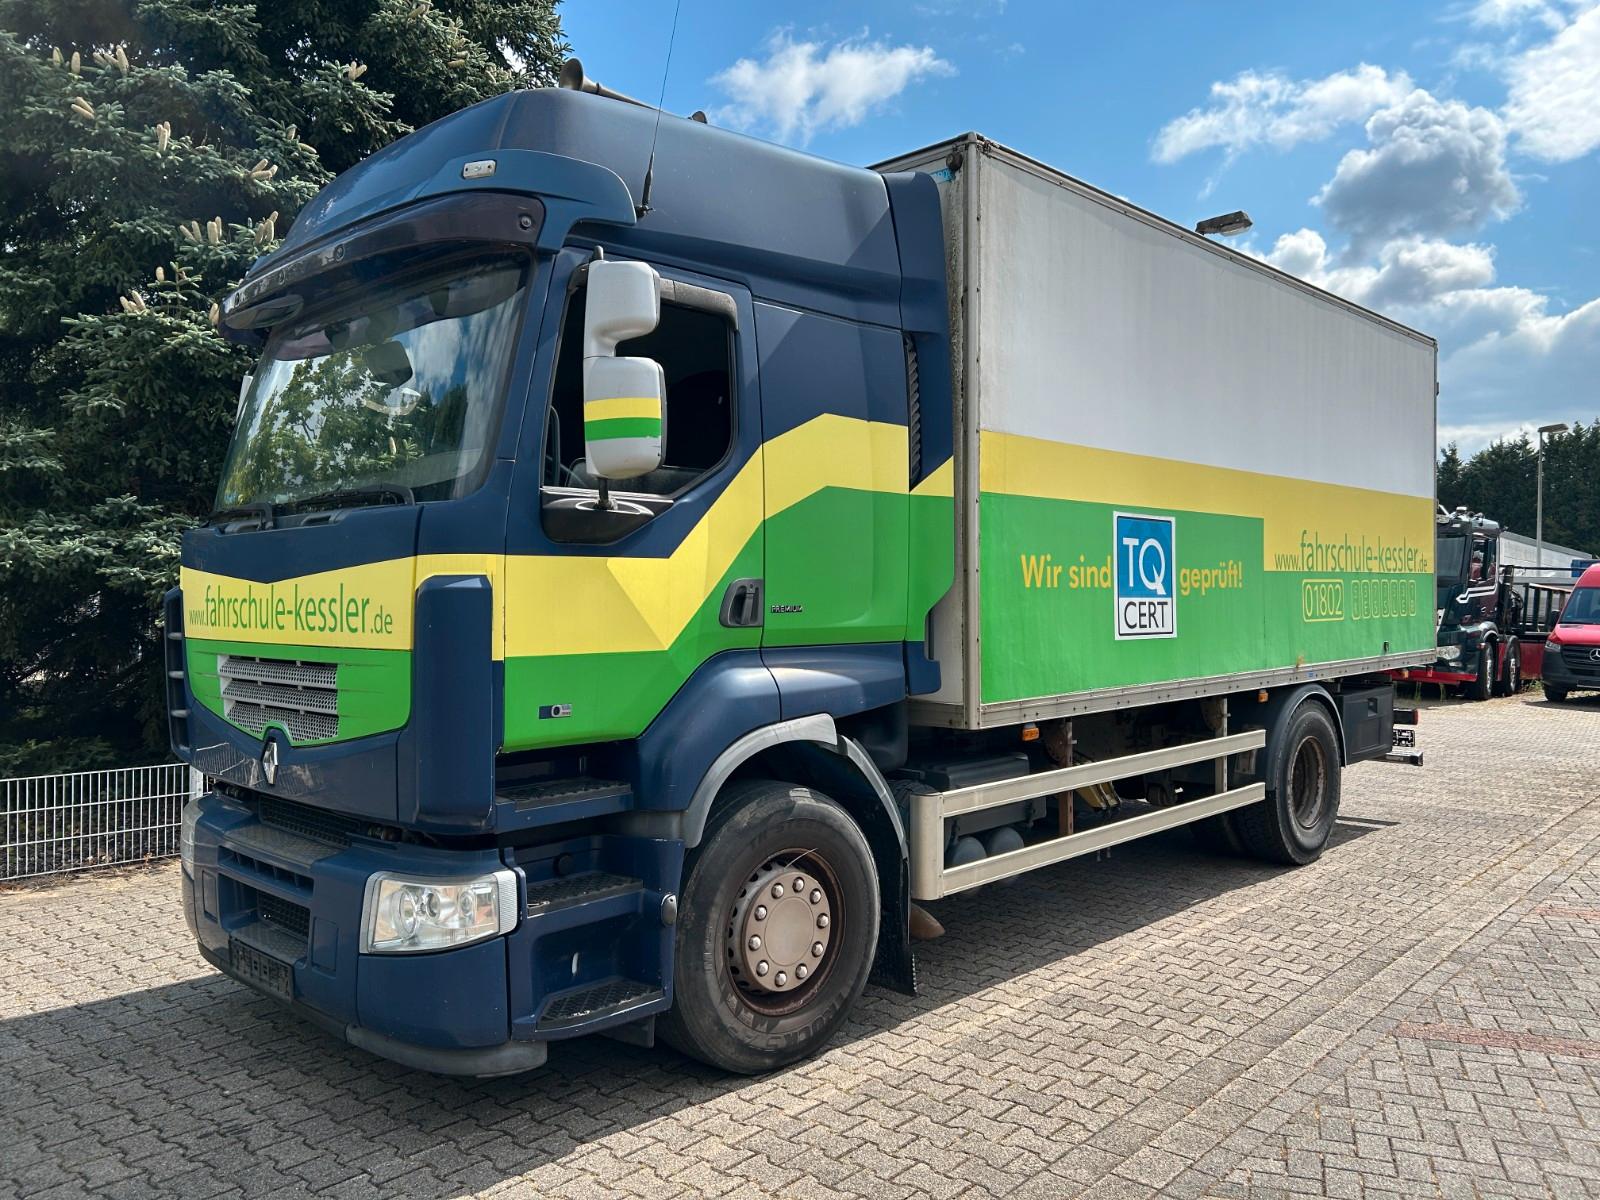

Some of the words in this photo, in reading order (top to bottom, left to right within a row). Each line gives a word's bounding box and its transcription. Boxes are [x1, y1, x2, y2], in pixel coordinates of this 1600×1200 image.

[1122, 537, 1167, 595] TQ
[1274, 529, 1428, 572] www.fahrschule-kessler.de
[1020, 554, 1062, 589] Wir
[1069, 555, 1112, 589] sind
[1179, 560, 1243, 596] geprüft!
[188, 583, 393, 634] www.fahrschule-kessler.de
[771, 605, 803, 613] PREMIUM
[1124, 601, 1168, 629] CERT
[1305, 583, 1343, 617] 01802
